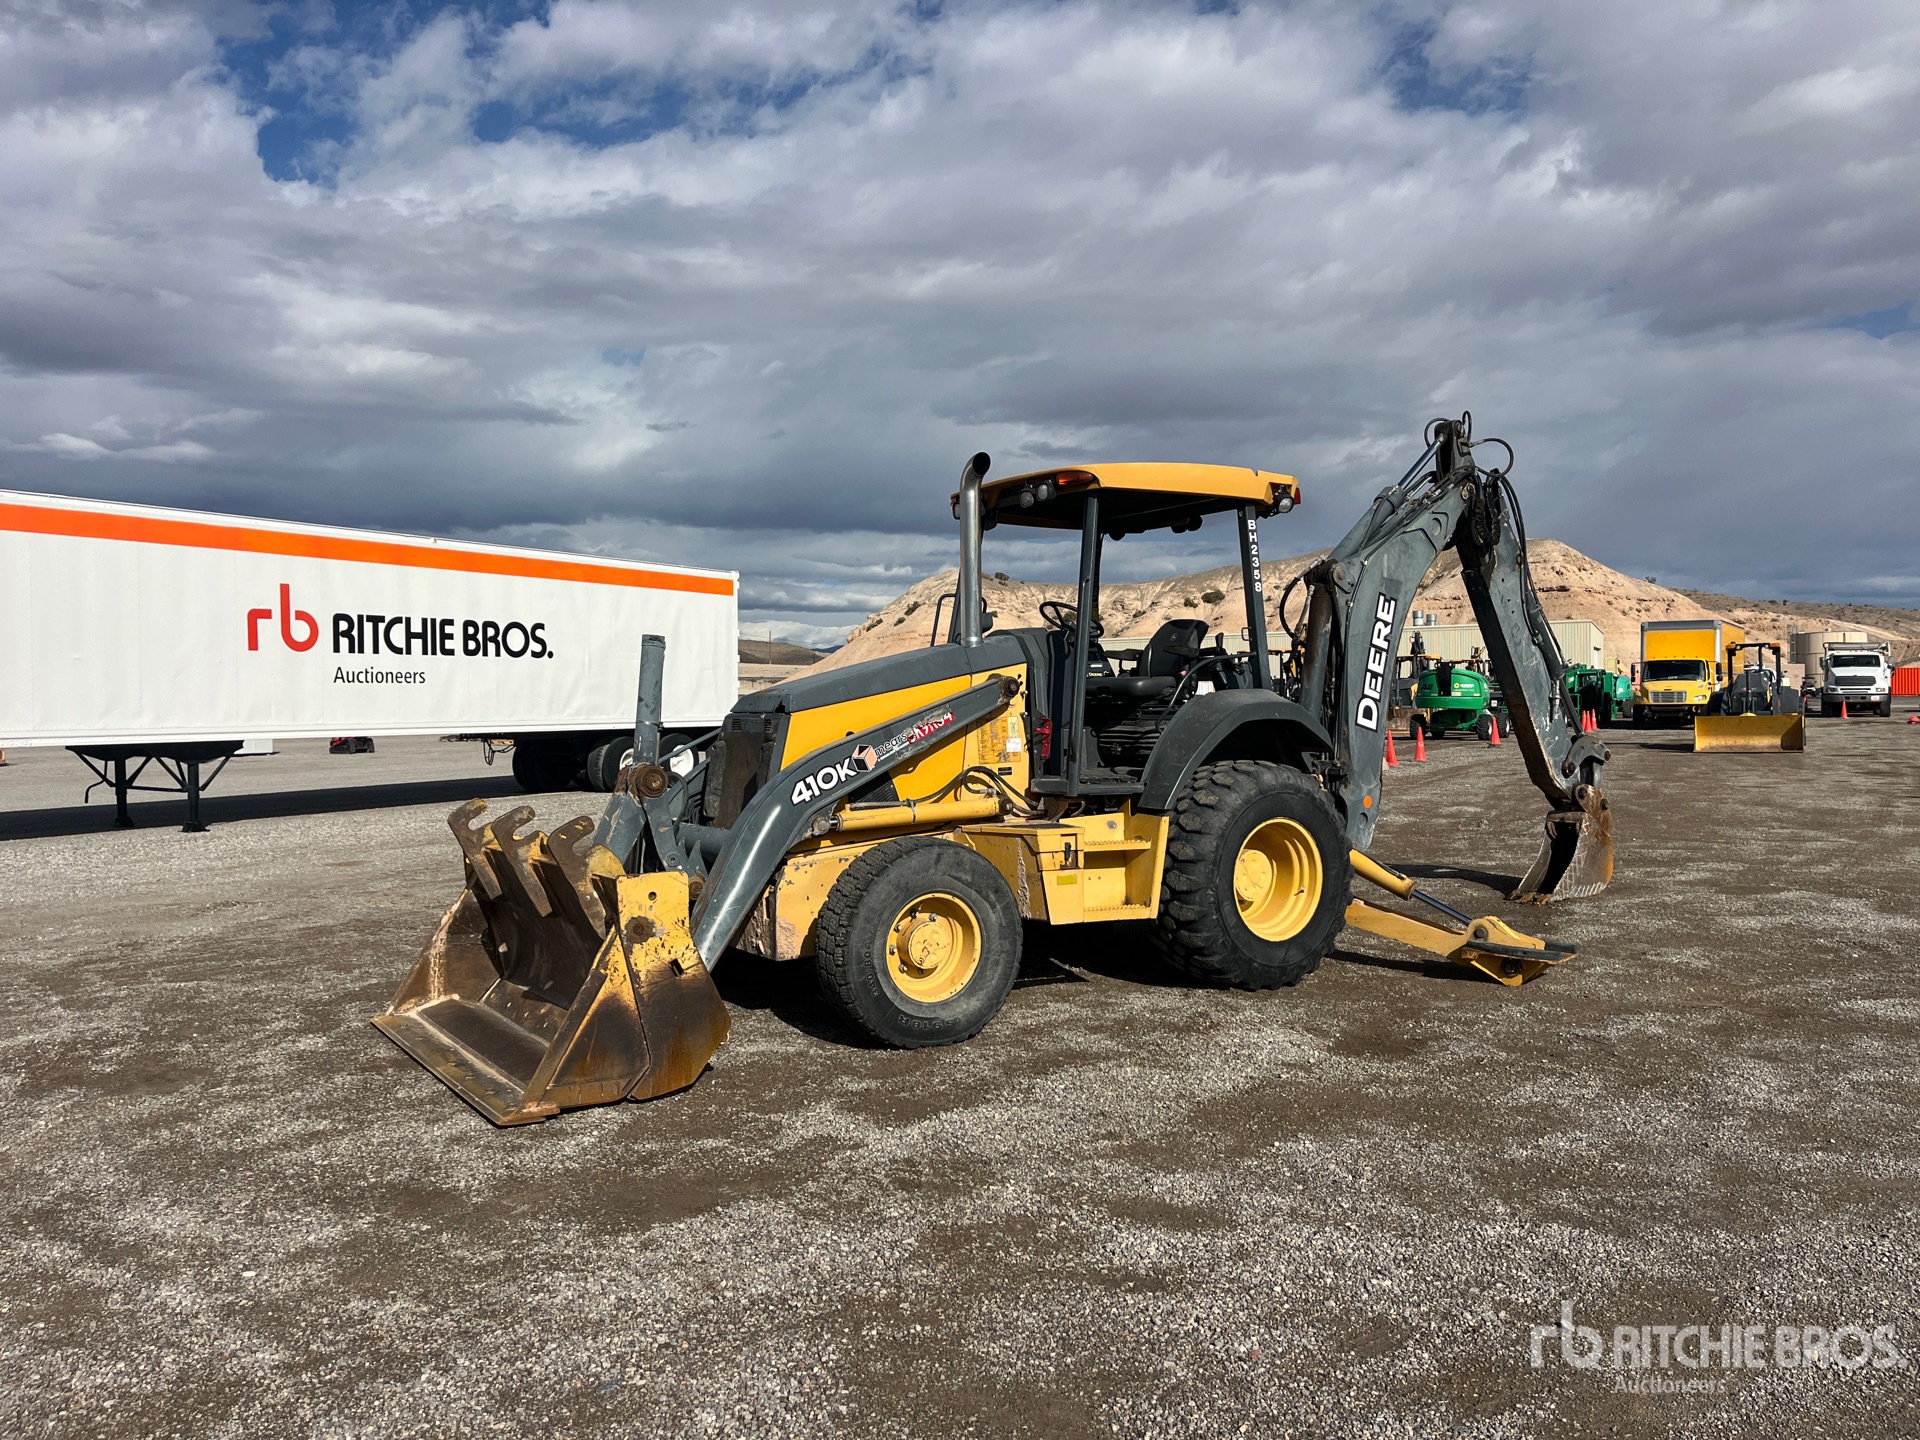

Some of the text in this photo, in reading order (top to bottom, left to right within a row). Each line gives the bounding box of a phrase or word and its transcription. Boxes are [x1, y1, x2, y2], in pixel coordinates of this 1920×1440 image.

[1247, 519, 1262, 592] BH2358
[247, 583, 554, 659] rb RITCHIE BROS.
[333, 666, 426, 684] Auctioneers
[1356, 594, 1396, 731] DEERE
[791, 757, 858, 805] 410K
